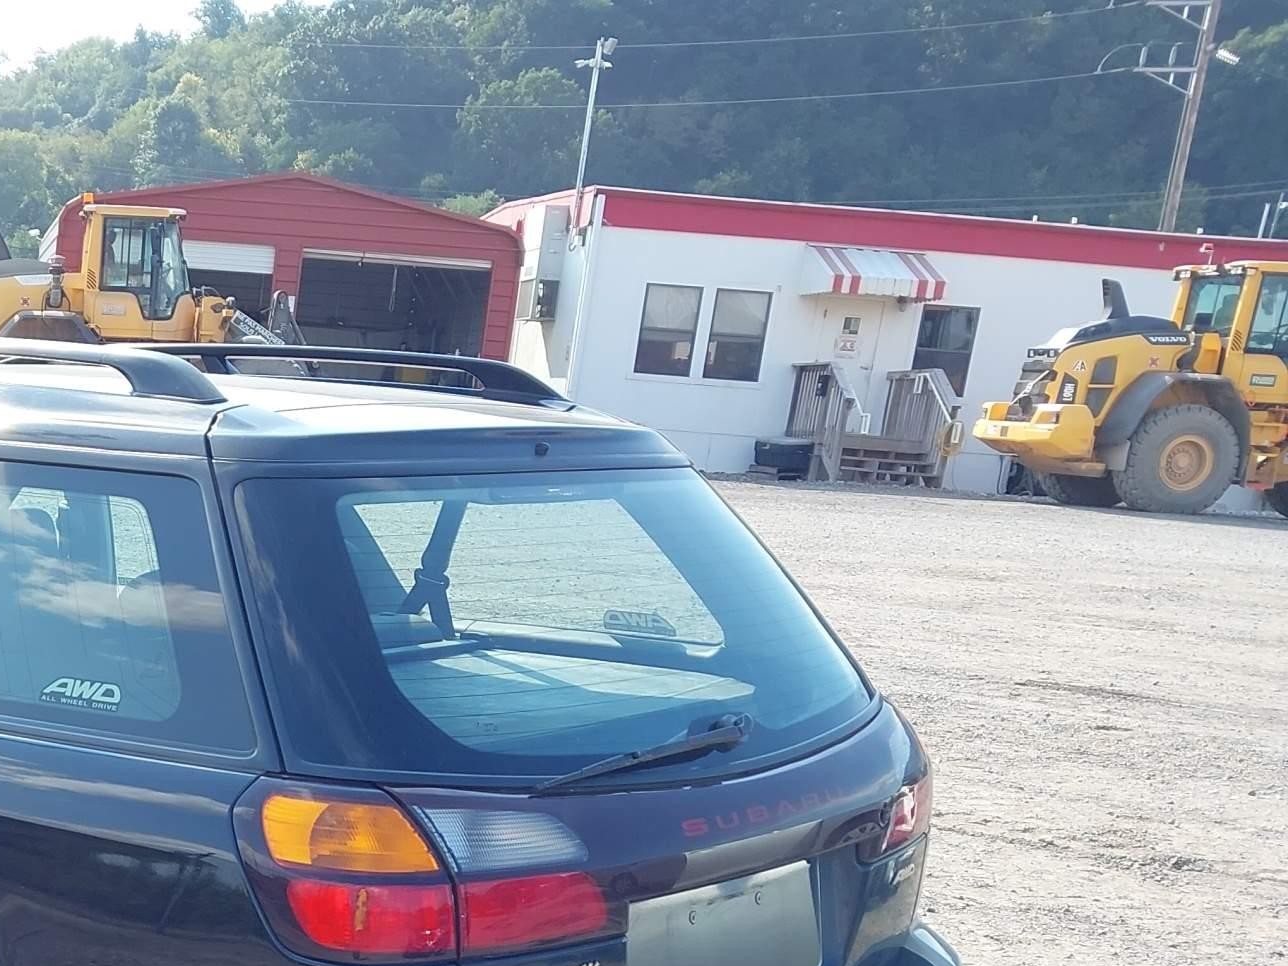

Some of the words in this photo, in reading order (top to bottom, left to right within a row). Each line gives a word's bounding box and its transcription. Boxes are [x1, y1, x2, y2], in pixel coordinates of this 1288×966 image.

[1062, 383, 1076, 401] L90H
[41, 677, 121, 703] AWD
[40, 694, 56, 702] ALL
[60, 697, 88, 707] WHEEL
[92, 701, 117, 711] DRIVE
[680, 787, 844, 837] SUBARU
